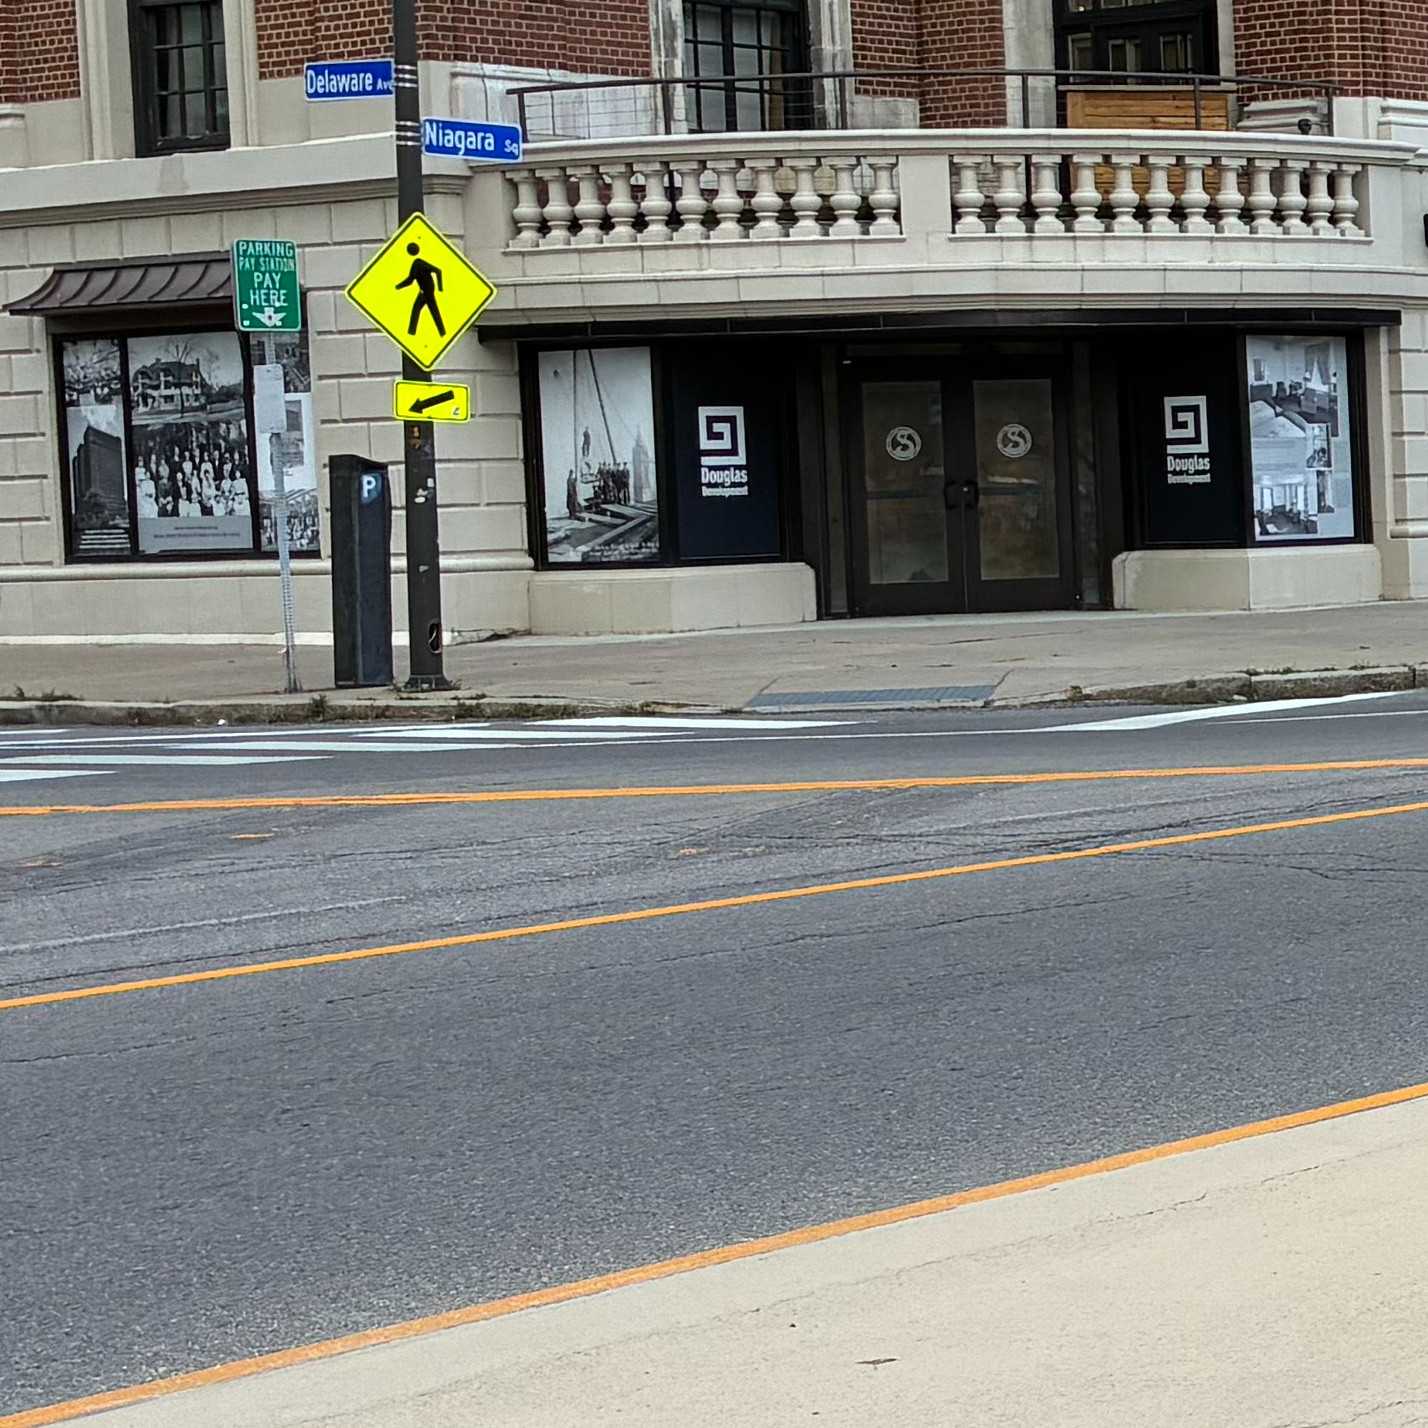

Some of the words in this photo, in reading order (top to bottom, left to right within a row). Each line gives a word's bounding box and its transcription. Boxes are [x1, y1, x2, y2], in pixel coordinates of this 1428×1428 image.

[306, 69, 373, 94] Delaware
[376, 78, 394, 92] Ave
[425, 121, 495, 156] Niagara
[504, 139, 519, 157] Sq
[239, 241, 294, 257] PARKING
[239, 257, 256, 271] PAY
[253, 272, 281, 289] PAY
[250, 289, 289, 307] HERE
[1166, 454, 1211, 474] Douglas
[701, 466, 749, 486] Douglas
[362, 475, 376, 498] P
